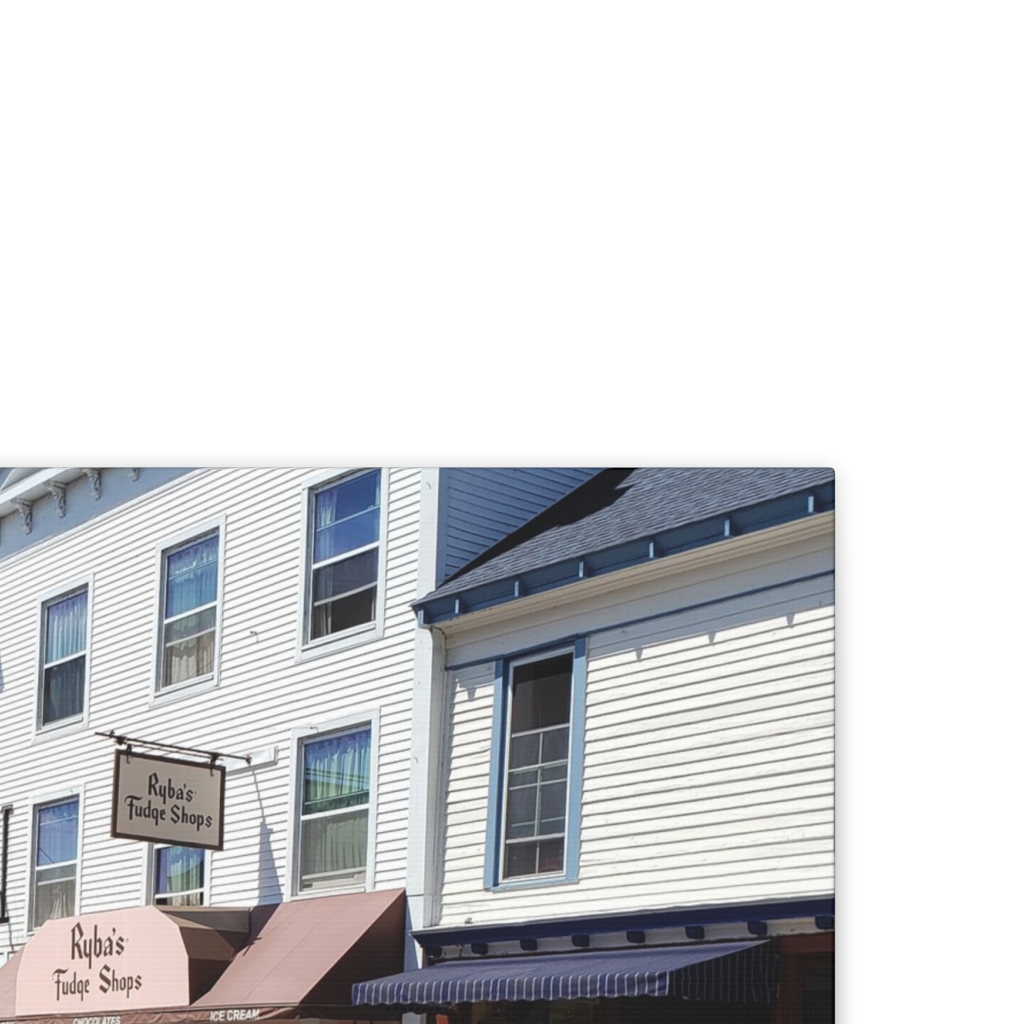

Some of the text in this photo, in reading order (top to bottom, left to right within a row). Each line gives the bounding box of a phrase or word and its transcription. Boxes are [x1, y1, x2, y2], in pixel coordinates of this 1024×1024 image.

[148, 772, 194, 805] Ryba's
[124, 795, 213, 831] Fudge Shops
[70, 921, 125, 970] Ryba's
[52, 964, 143, 1002] Fudge Shops
[210, 1009, 260, 1022] ICE CREAM
